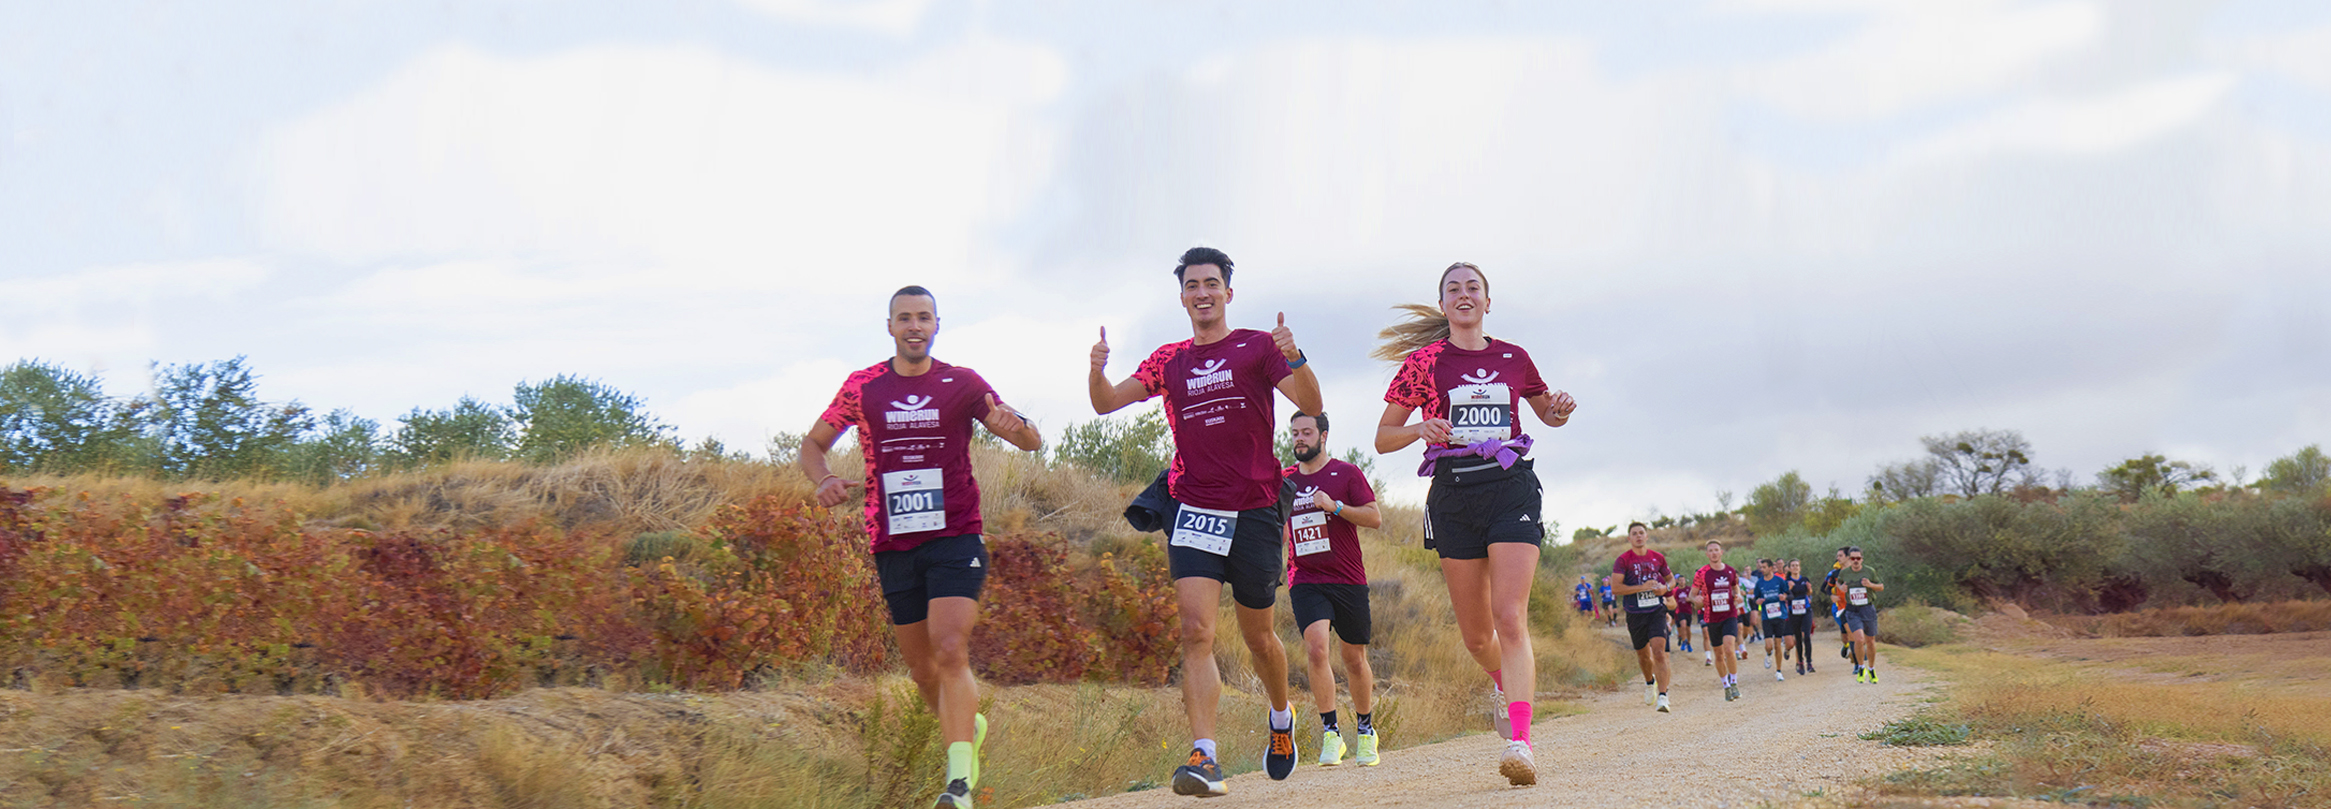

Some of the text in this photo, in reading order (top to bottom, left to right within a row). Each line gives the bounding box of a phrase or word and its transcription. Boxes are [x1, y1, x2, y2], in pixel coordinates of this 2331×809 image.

[1207, 381, 1235, 393] ALAVESA
[909, 421, 940, 429] ALAVESA
[1458, 406, 1501, 426] 2000
[893, 492, 934, 514] 2001
[1183, 513, 1228, 535] 2015
[1297, 526, 1322, 542] 1421
